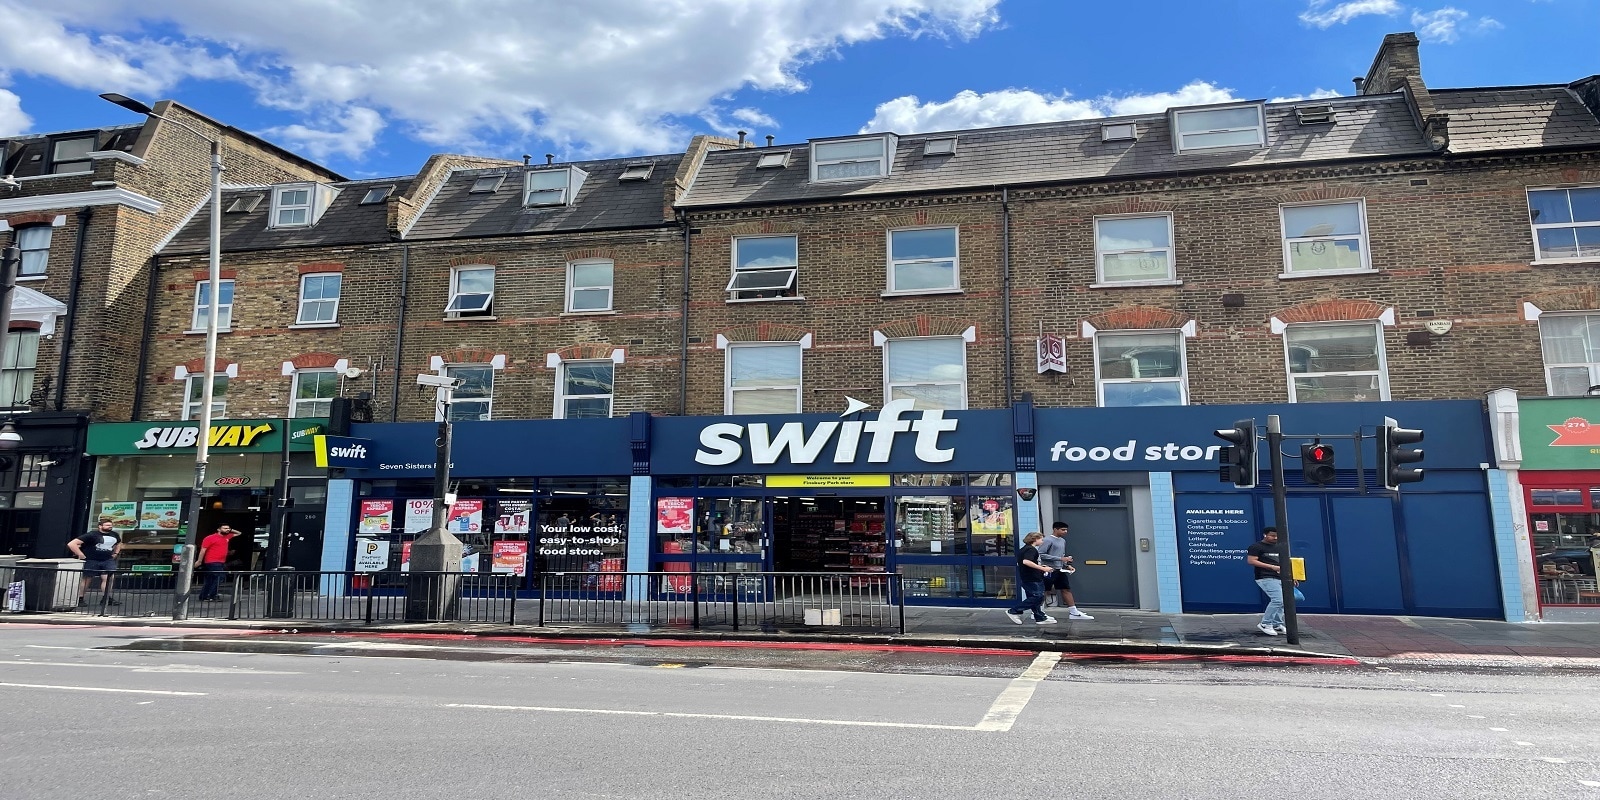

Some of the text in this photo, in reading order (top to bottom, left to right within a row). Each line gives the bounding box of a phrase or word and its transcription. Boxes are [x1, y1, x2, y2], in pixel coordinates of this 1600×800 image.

[291, 426, 320, 439] SUBWAY
[694, 394, 959, 466] swift
[134, 423, 272, 449] SUBWAY
[330, 443, 366, 459] swift
[1050, 440, 1222, 462] food stor
[404, 462, 432, 470] Sisters
[217, 477, 244, 485] OPEN
[409, 500, 434, 509] 10%
[540, 524, 622, 534] Your low cost,
[539, 536, 620, 546] easy-to-shop
[539, 547, 604, 555] food store.
